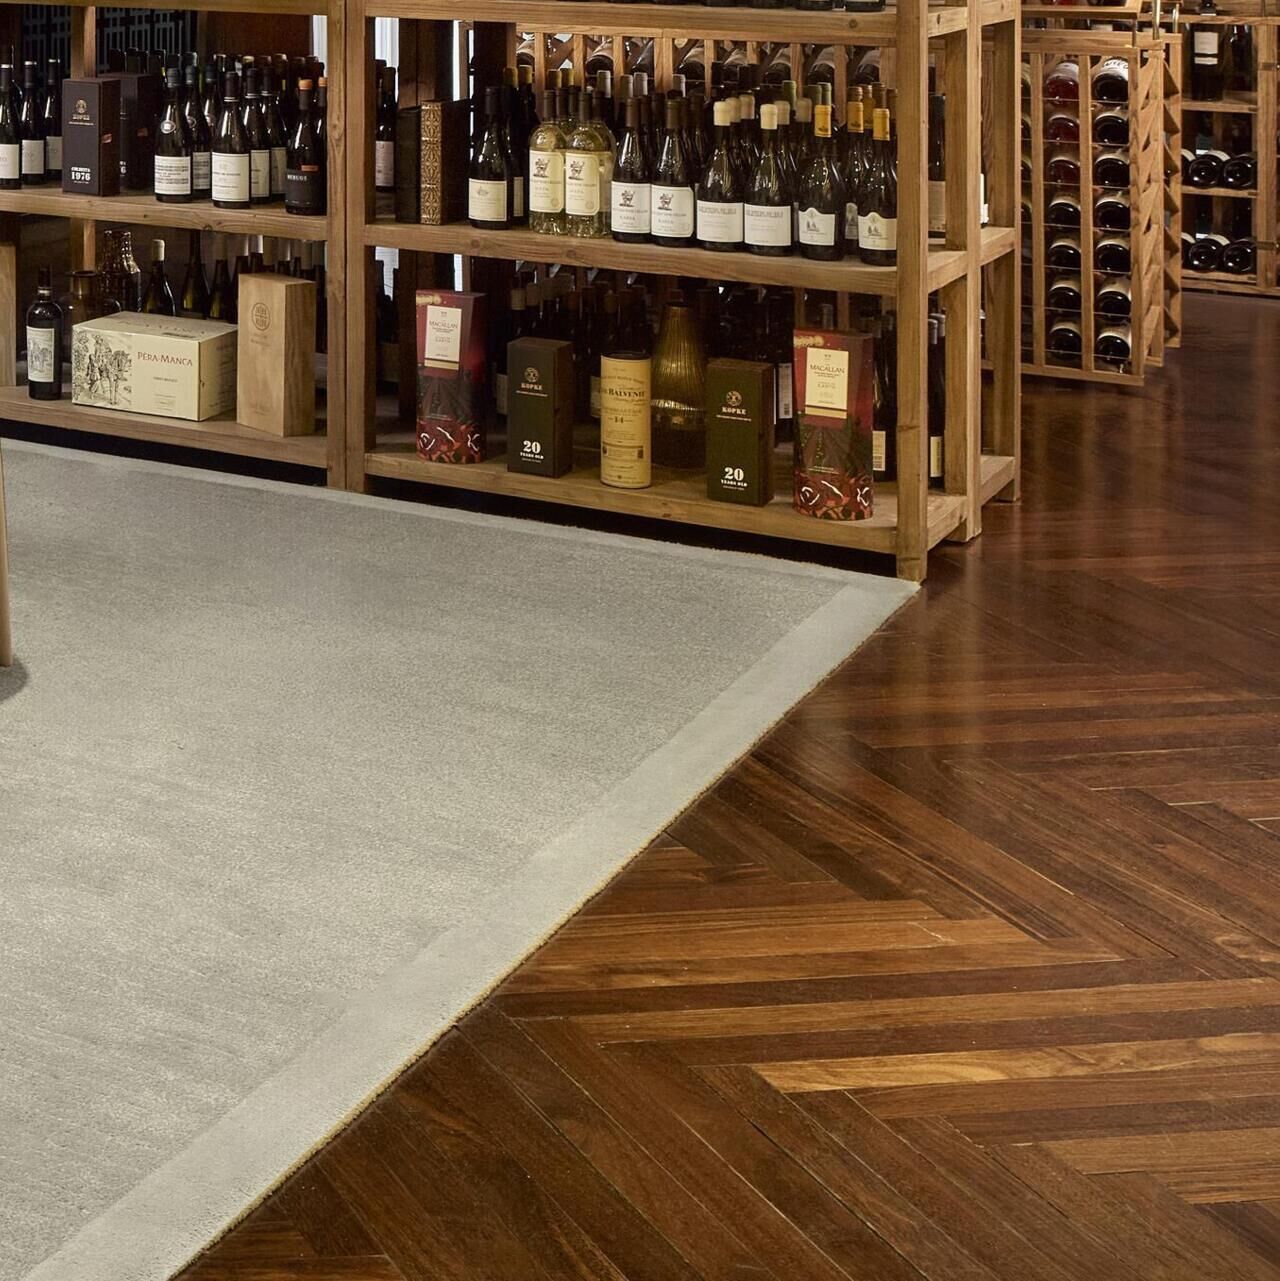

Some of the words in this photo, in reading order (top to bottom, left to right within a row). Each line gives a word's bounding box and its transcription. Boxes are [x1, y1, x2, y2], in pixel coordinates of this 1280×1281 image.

[71, 172, 91, 181] 1976
[809, 364, 845, 374] MACALLAN
[722, 406, 747, 415] KOPKE
[522, 440, 541, 454] 20
[724, 467, 744, 481] 20
